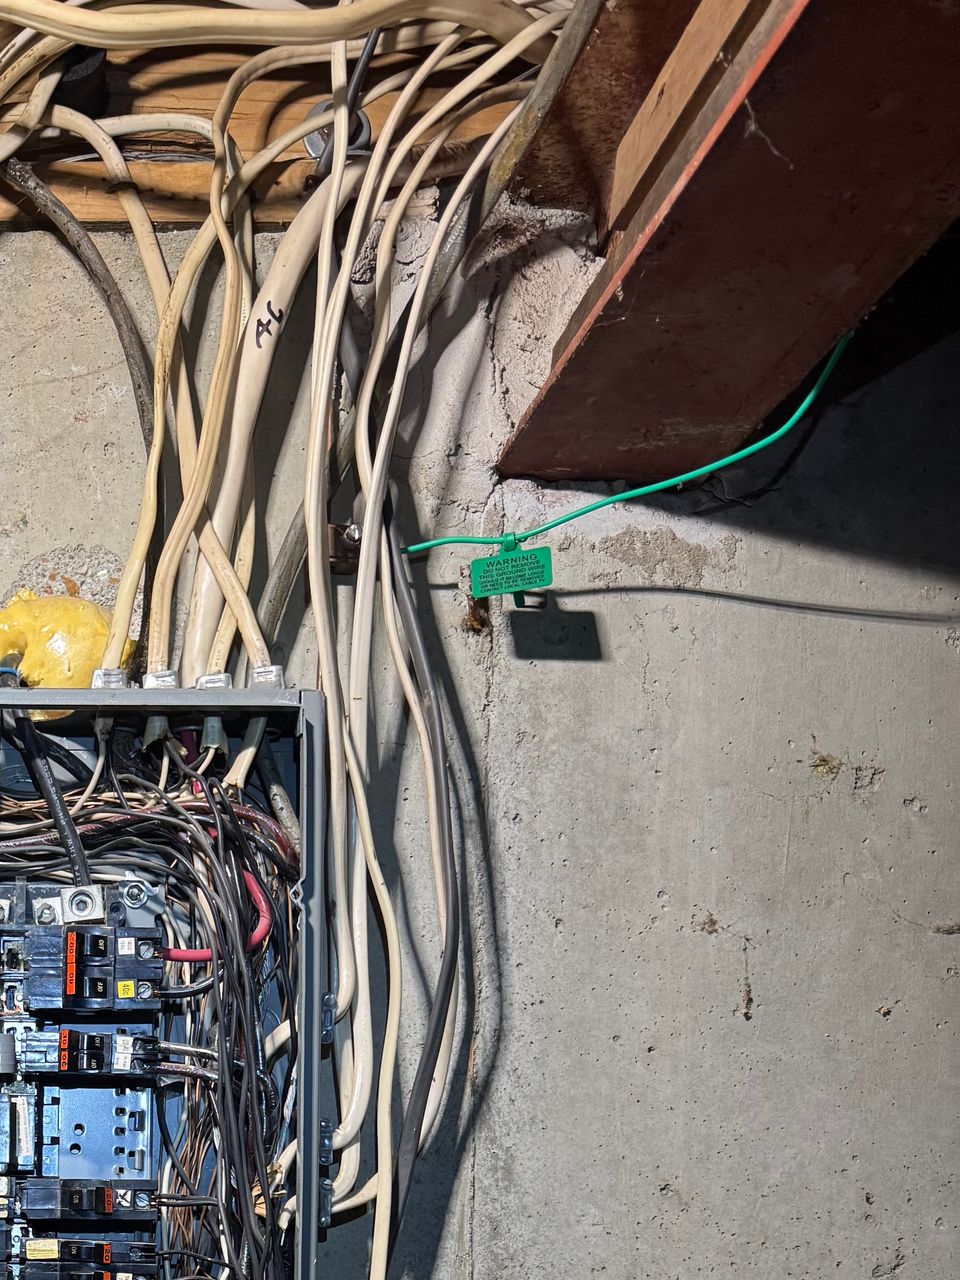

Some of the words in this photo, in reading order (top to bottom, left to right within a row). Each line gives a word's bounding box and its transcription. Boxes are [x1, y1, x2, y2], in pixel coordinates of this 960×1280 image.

[486, 553, 538, 568] WARNING
[511, 560, 540, 569] REMOVE
[495, 568, 526, 578] GROUND
[106, 1193, 112, 1206] 20
[105, 1249, 110, 1261] 20
